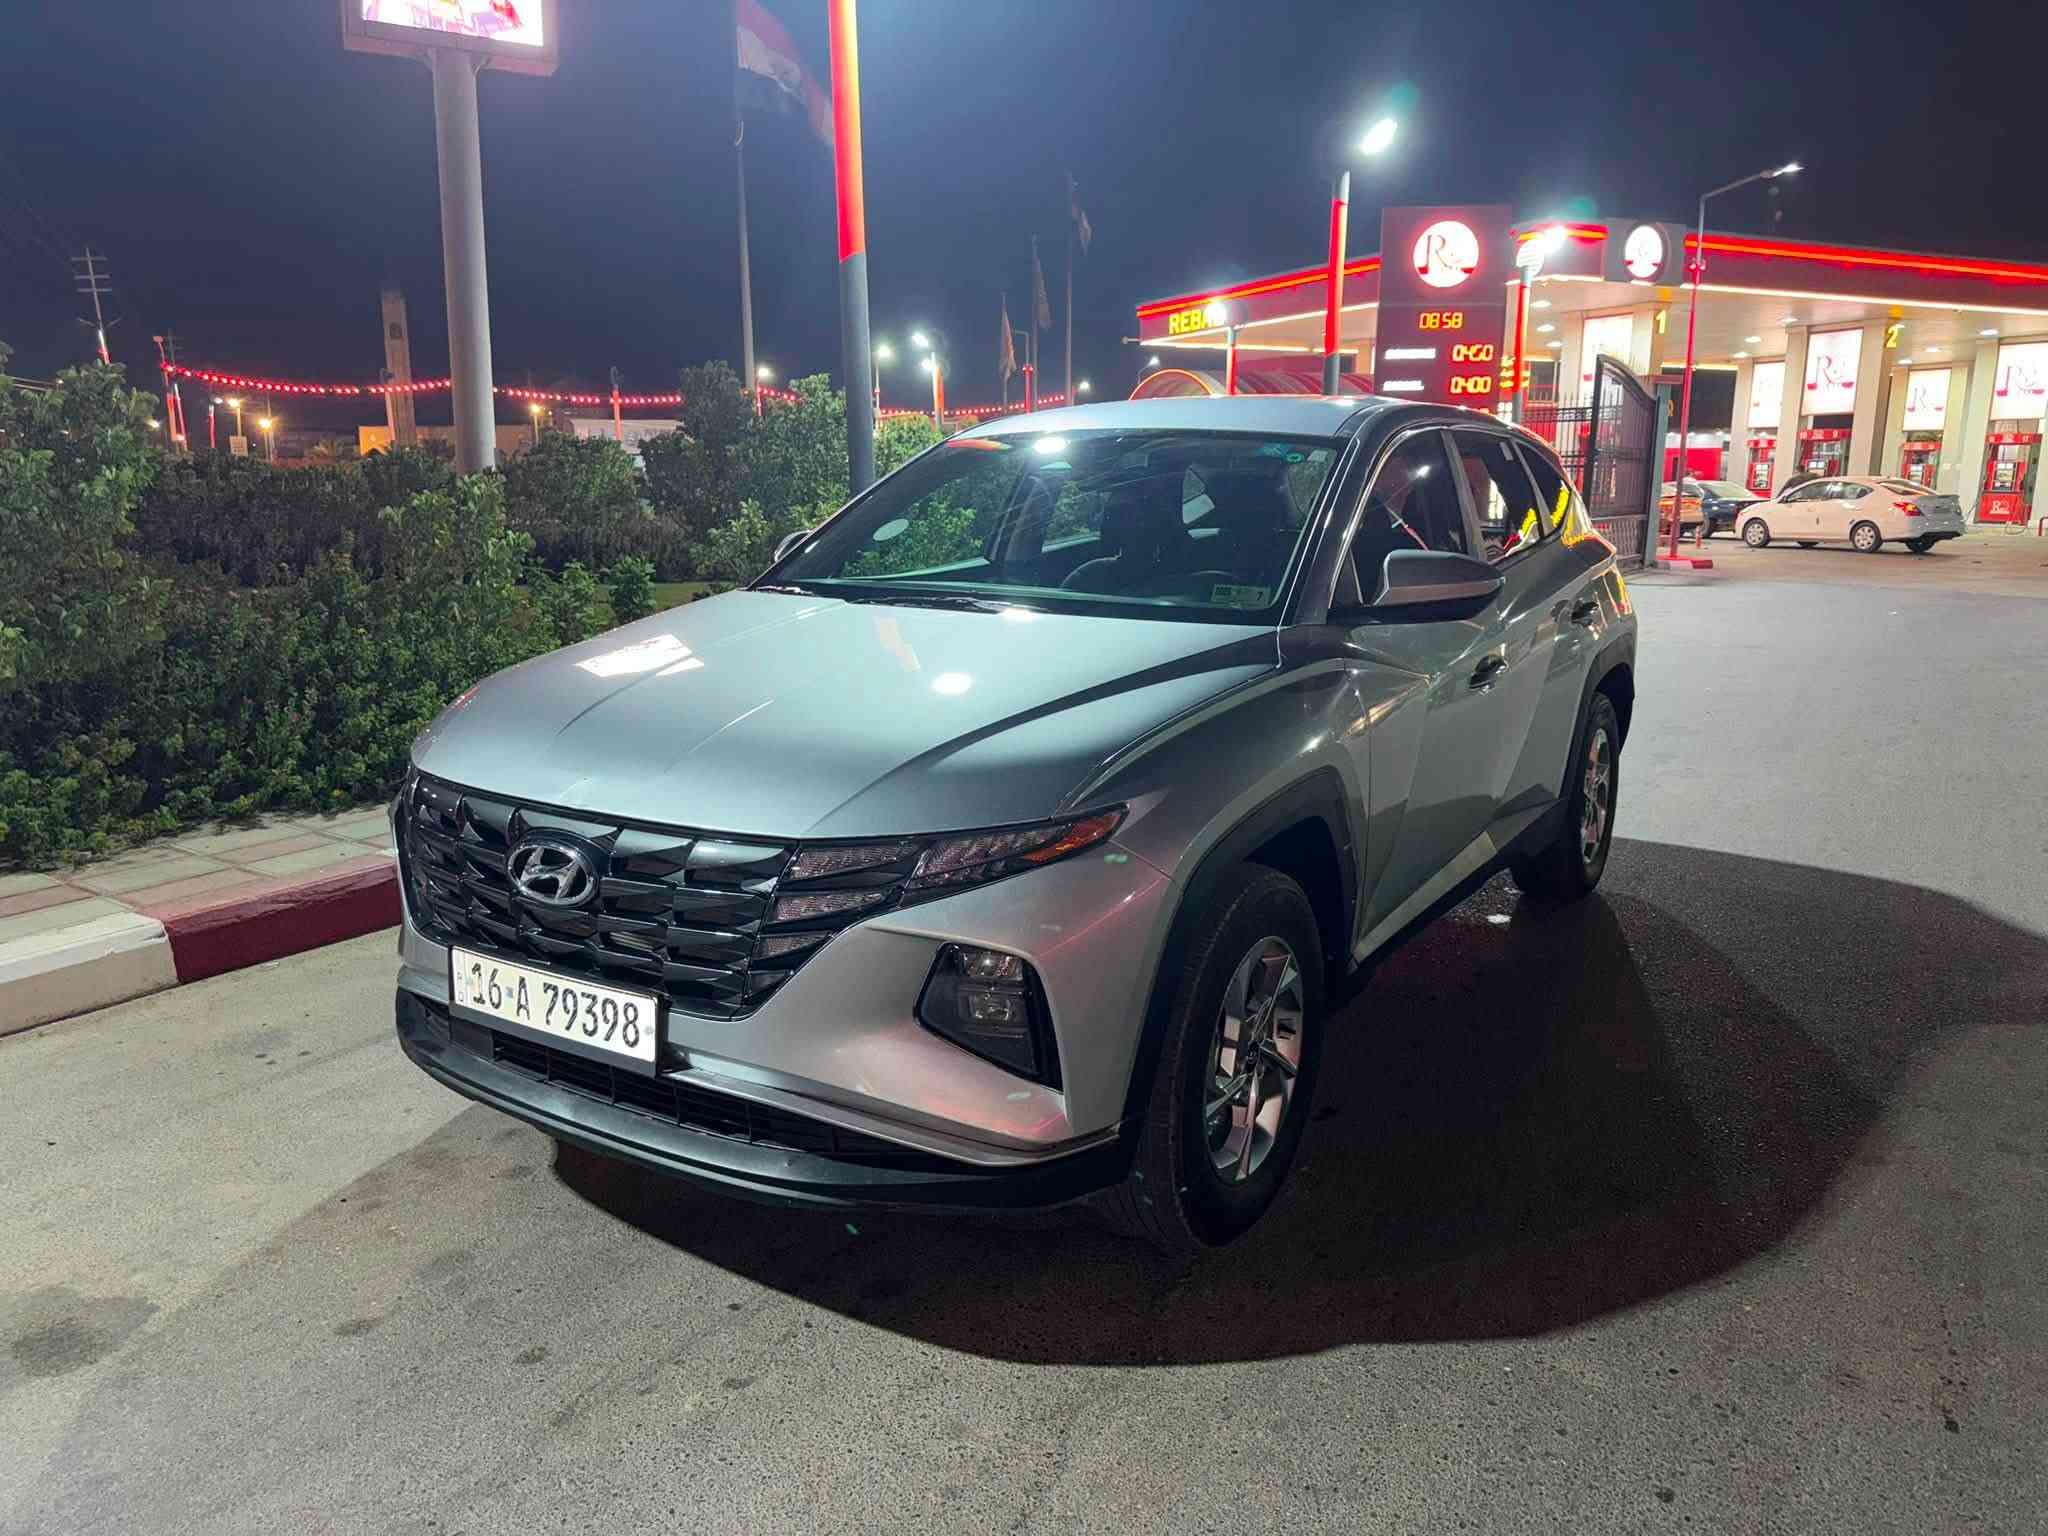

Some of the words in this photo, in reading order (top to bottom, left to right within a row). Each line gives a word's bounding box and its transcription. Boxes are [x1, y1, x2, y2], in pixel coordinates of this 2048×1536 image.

[1656, 309, 1666, 334] 1
[1887, 326, 1899, 348] 2
[1450, 376, 1491, 394] 0400
[471, 962, 502, 1010] 16
[516, 975, 531, 1021] A
[542, 981, 640, 1049] 79398
